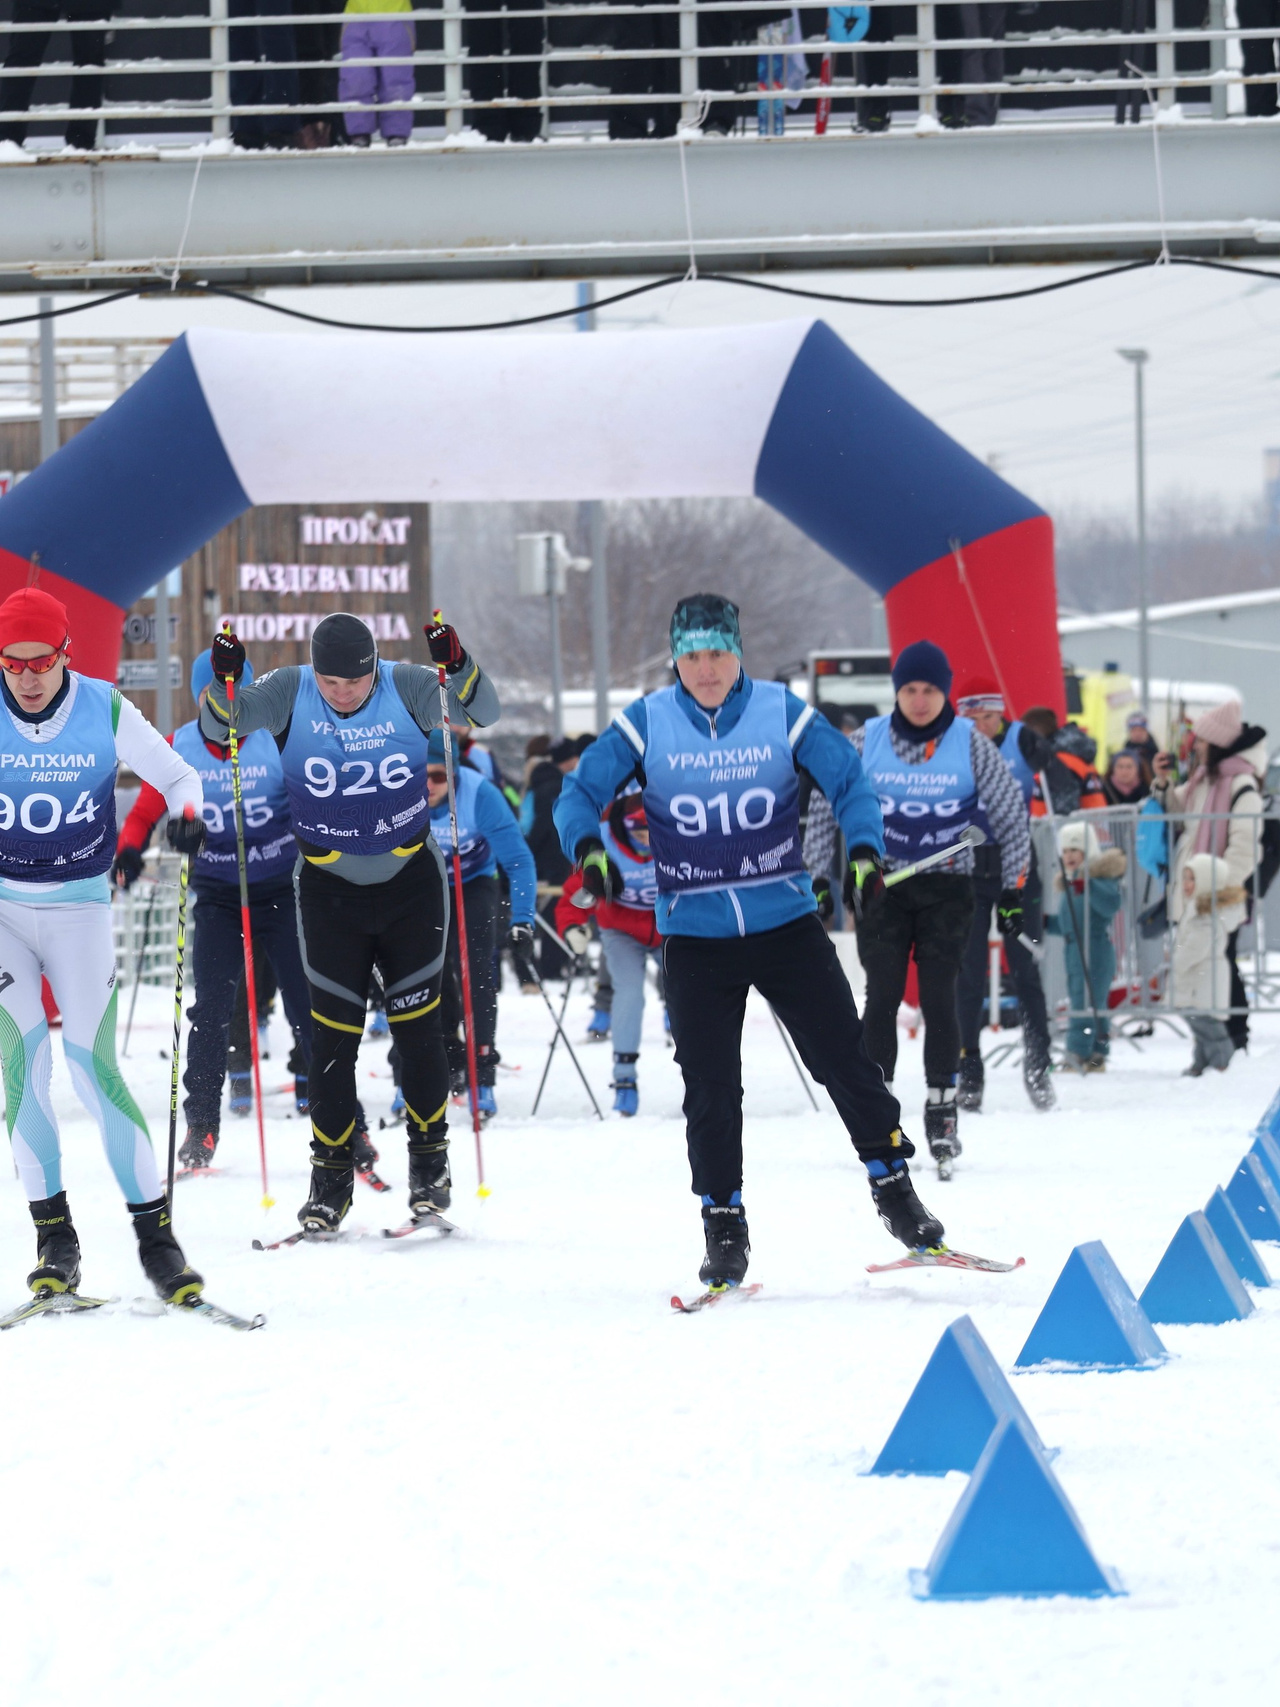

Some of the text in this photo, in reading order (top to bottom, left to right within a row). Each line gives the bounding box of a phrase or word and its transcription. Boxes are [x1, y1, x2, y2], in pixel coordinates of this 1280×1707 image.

[301, 516, 411, 545] ПРОКАТ
[239, 563, 410, 597] РАЗДЕВАЛКИ
[216, 613, 411, 641] СПОРТЛА
[216, 636, 234, 648] LEKI
[344, 738, 386, 752] FACTORY
[667, 745, 772, 770] УРАЛХИМ
[30, 771, 81, 782] FACTORY
[200, 765, 267, 782] РАЛИМ
[304, 753, 414, 797] 926
[710, 765, 758, 783] FACTORY
[873, 772, 957, 786] УРАЛХИМ
[221, 780, 257, 793] FAORY
[202, 796, 273, 833] 915
[670, 787, 775, 837] 910
[34, 1216, 65, 1226] SCHER
